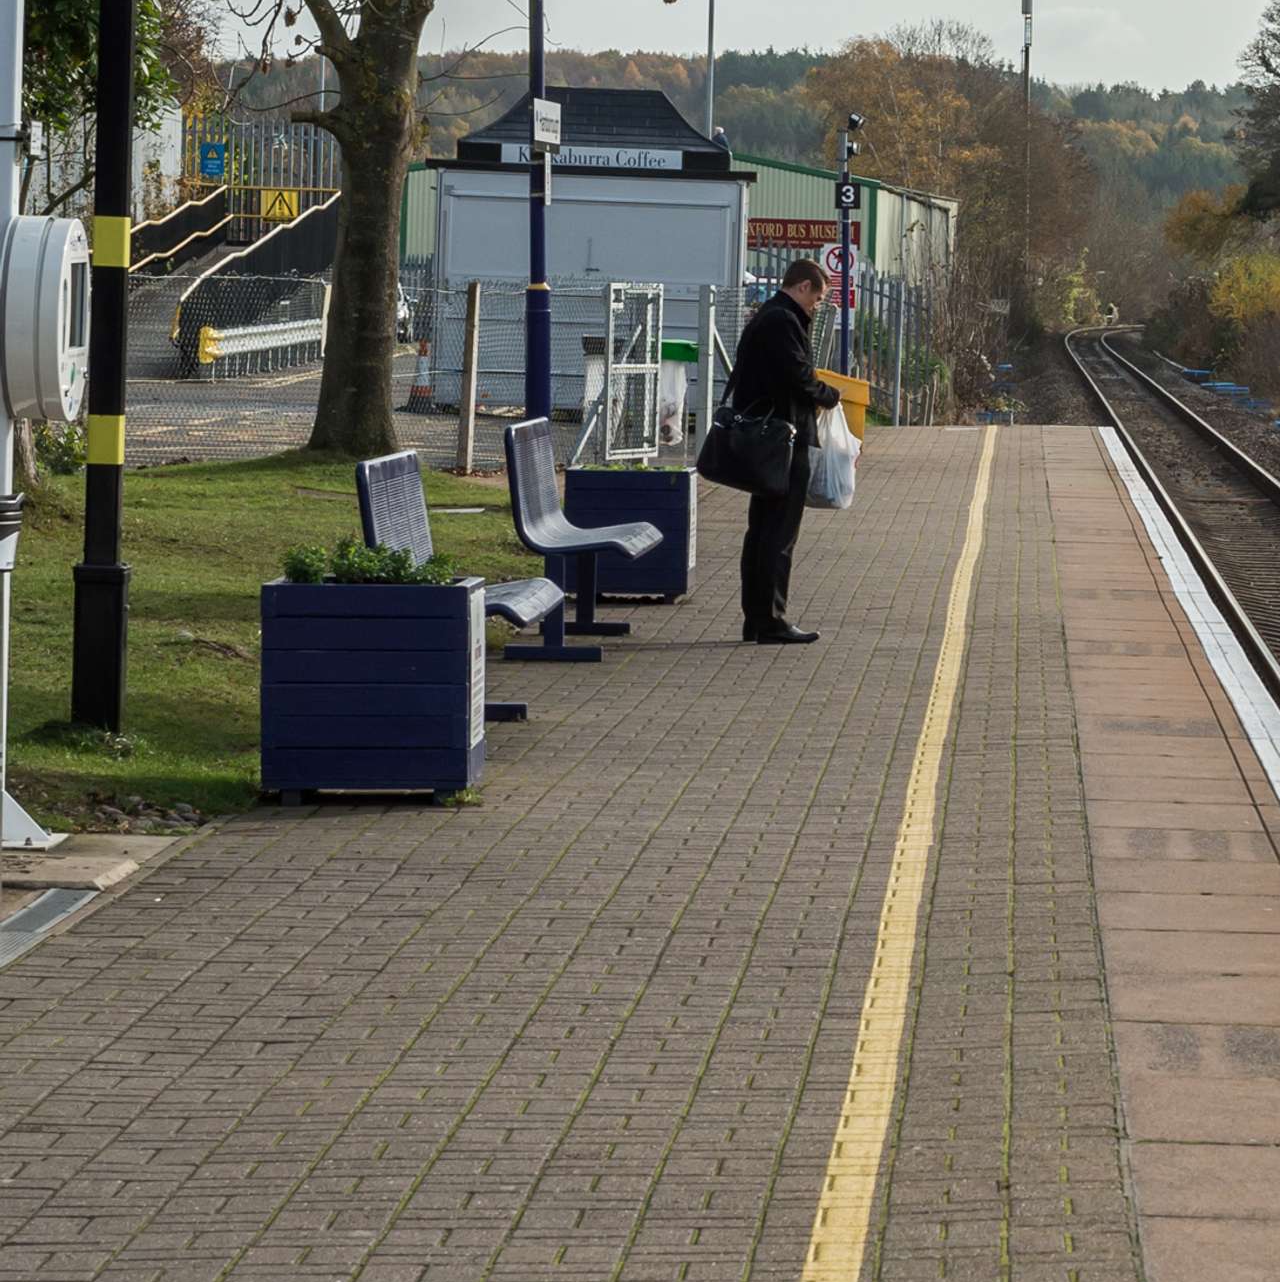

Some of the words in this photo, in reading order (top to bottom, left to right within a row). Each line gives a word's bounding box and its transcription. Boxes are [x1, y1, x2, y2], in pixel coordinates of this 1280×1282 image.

[518, 146, 610, 167] Kkaburra
[615, 149, 667, 168] Coffee
[841, 185, 855, 203] 3
[748, 222, 784, 238] XFORD
[787, 223, 807, 238] BUS
[809, 224, 855, 239] MUSE
